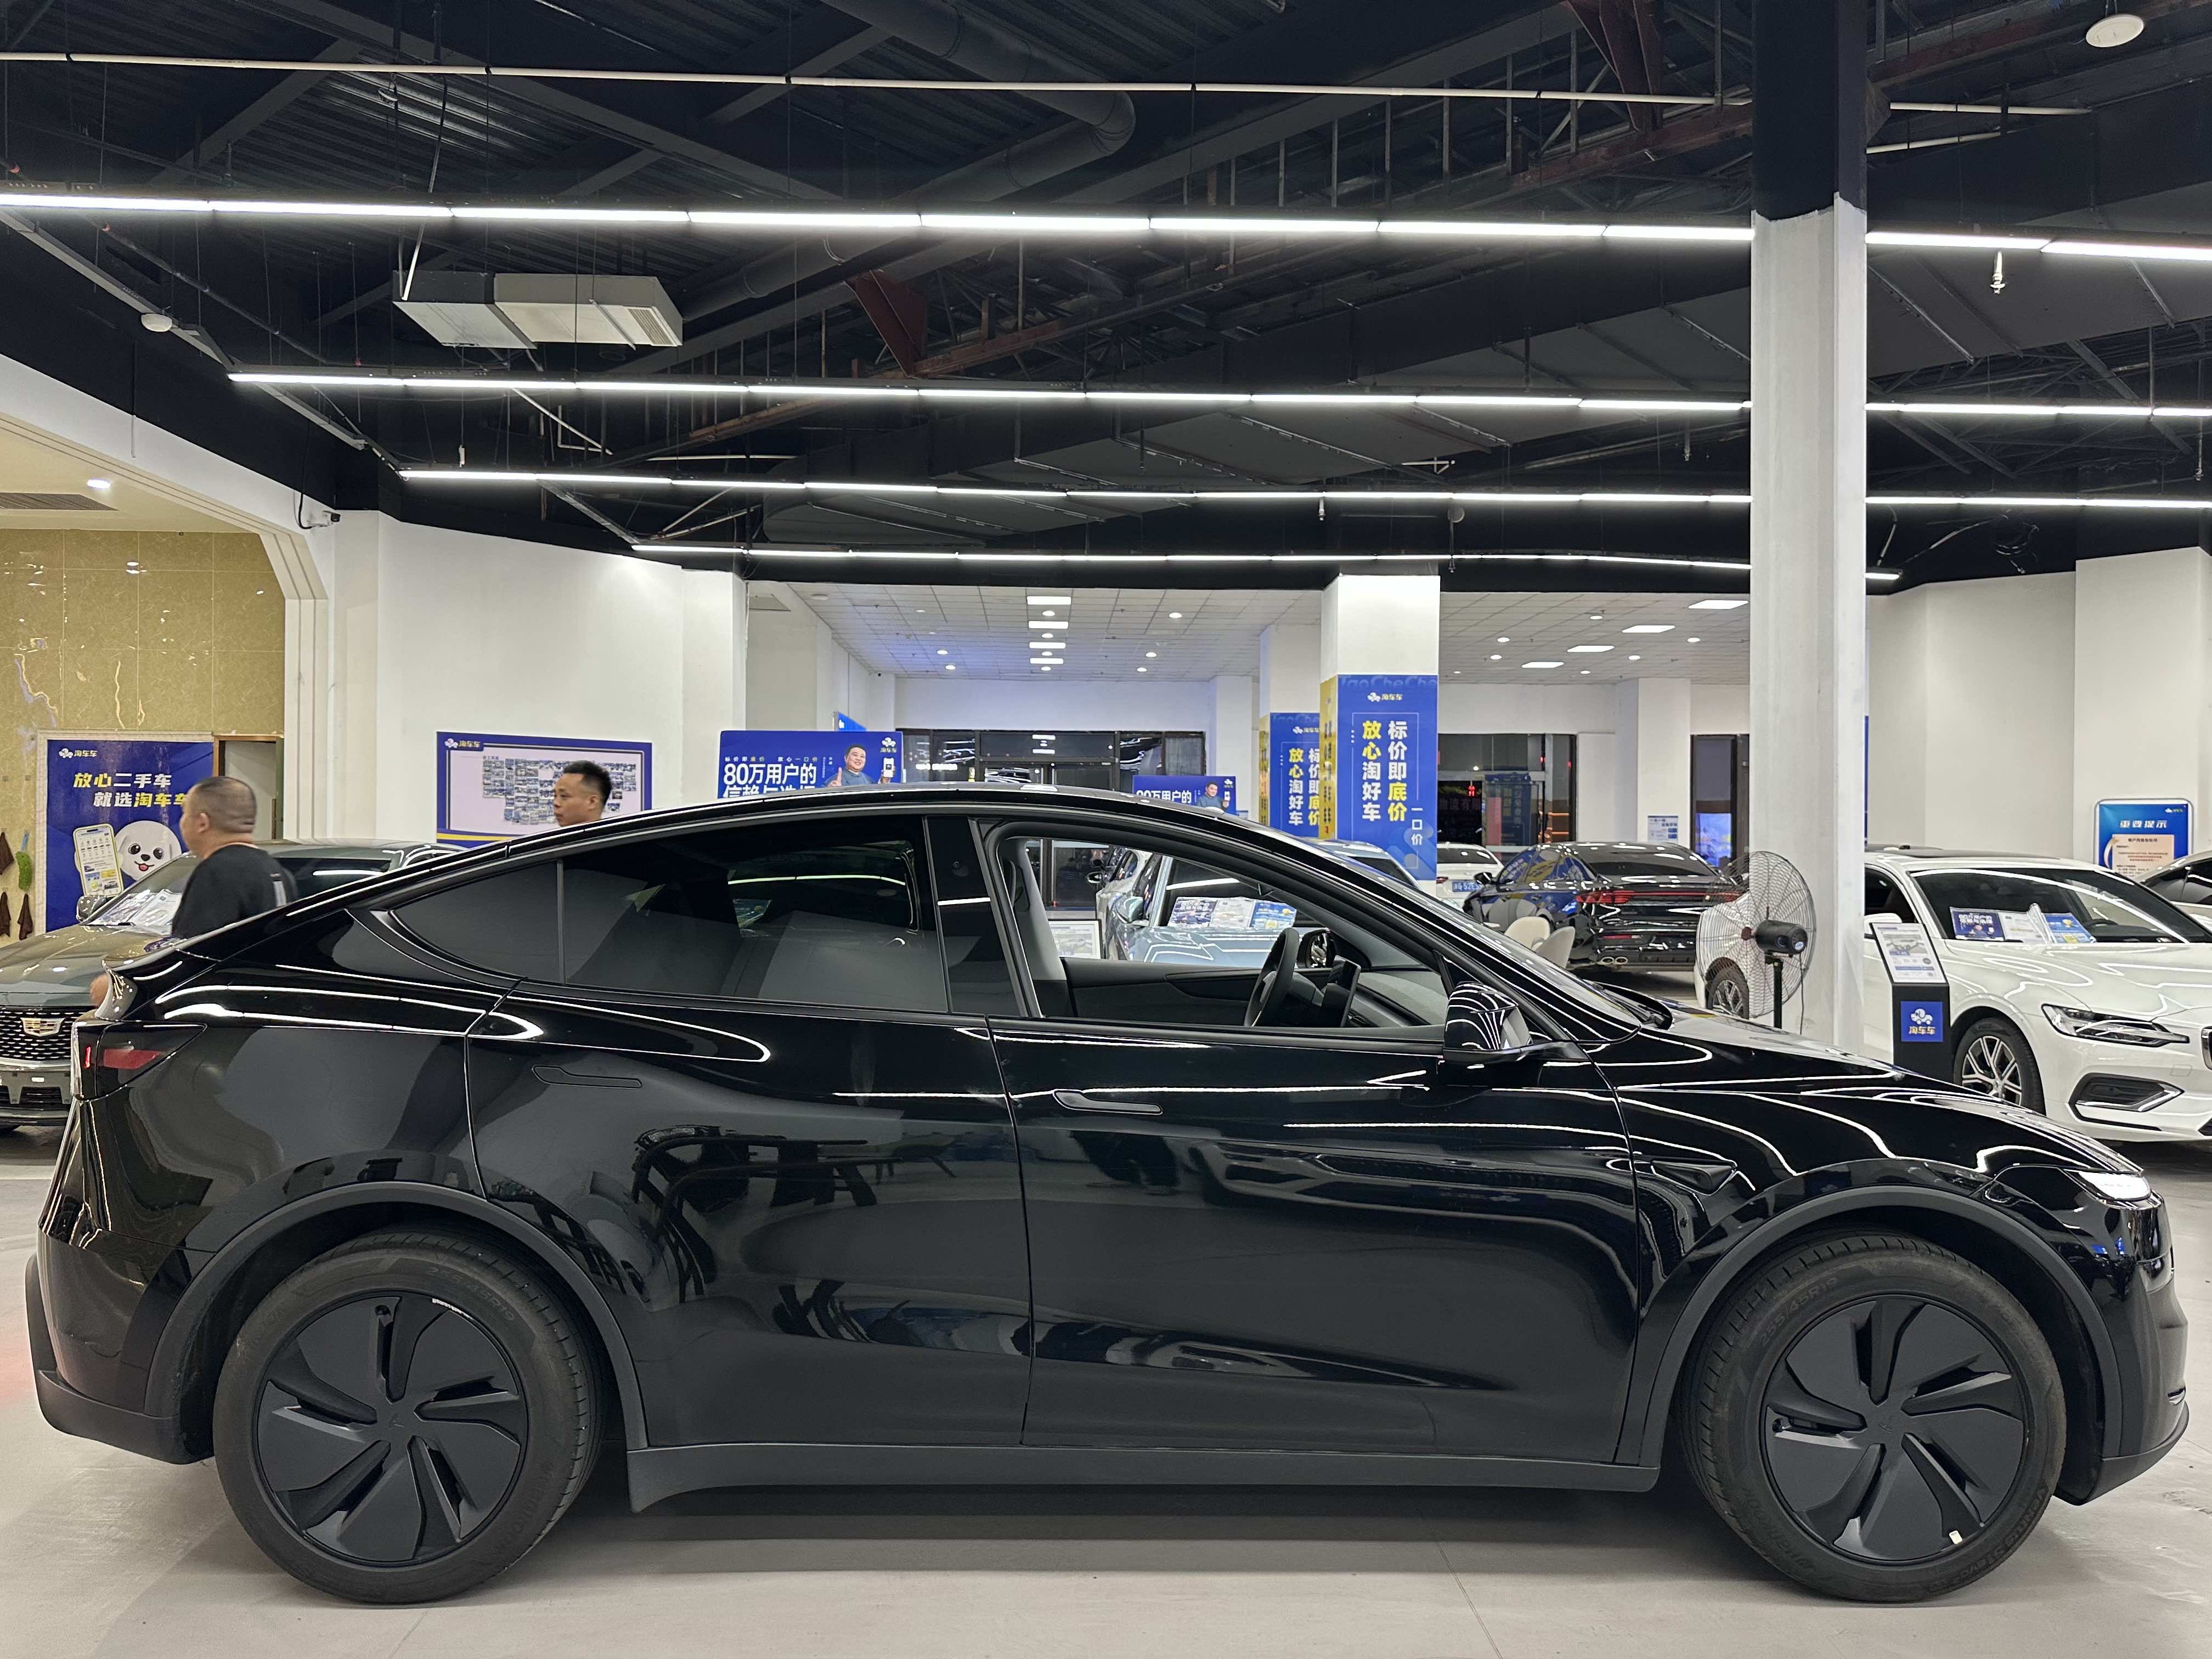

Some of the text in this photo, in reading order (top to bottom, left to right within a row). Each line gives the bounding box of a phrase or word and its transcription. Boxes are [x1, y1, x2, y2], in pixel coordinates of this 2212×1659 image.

[73, 772, 172, 788] 放心二手车
[724, 763, 816, 785] 80万用户的
[1361, 720, 1381, 822] 放心淘好车
[1388, 720, 1408, 822] 标价即底价
[1289, 748, 1304, 826] 放心淘好车
[1411, 807, 1423, 845] 一口价
[2120, 820, 2167, 828] 重要提示
[1909, 1026, 1936, 1035] 淘车车
